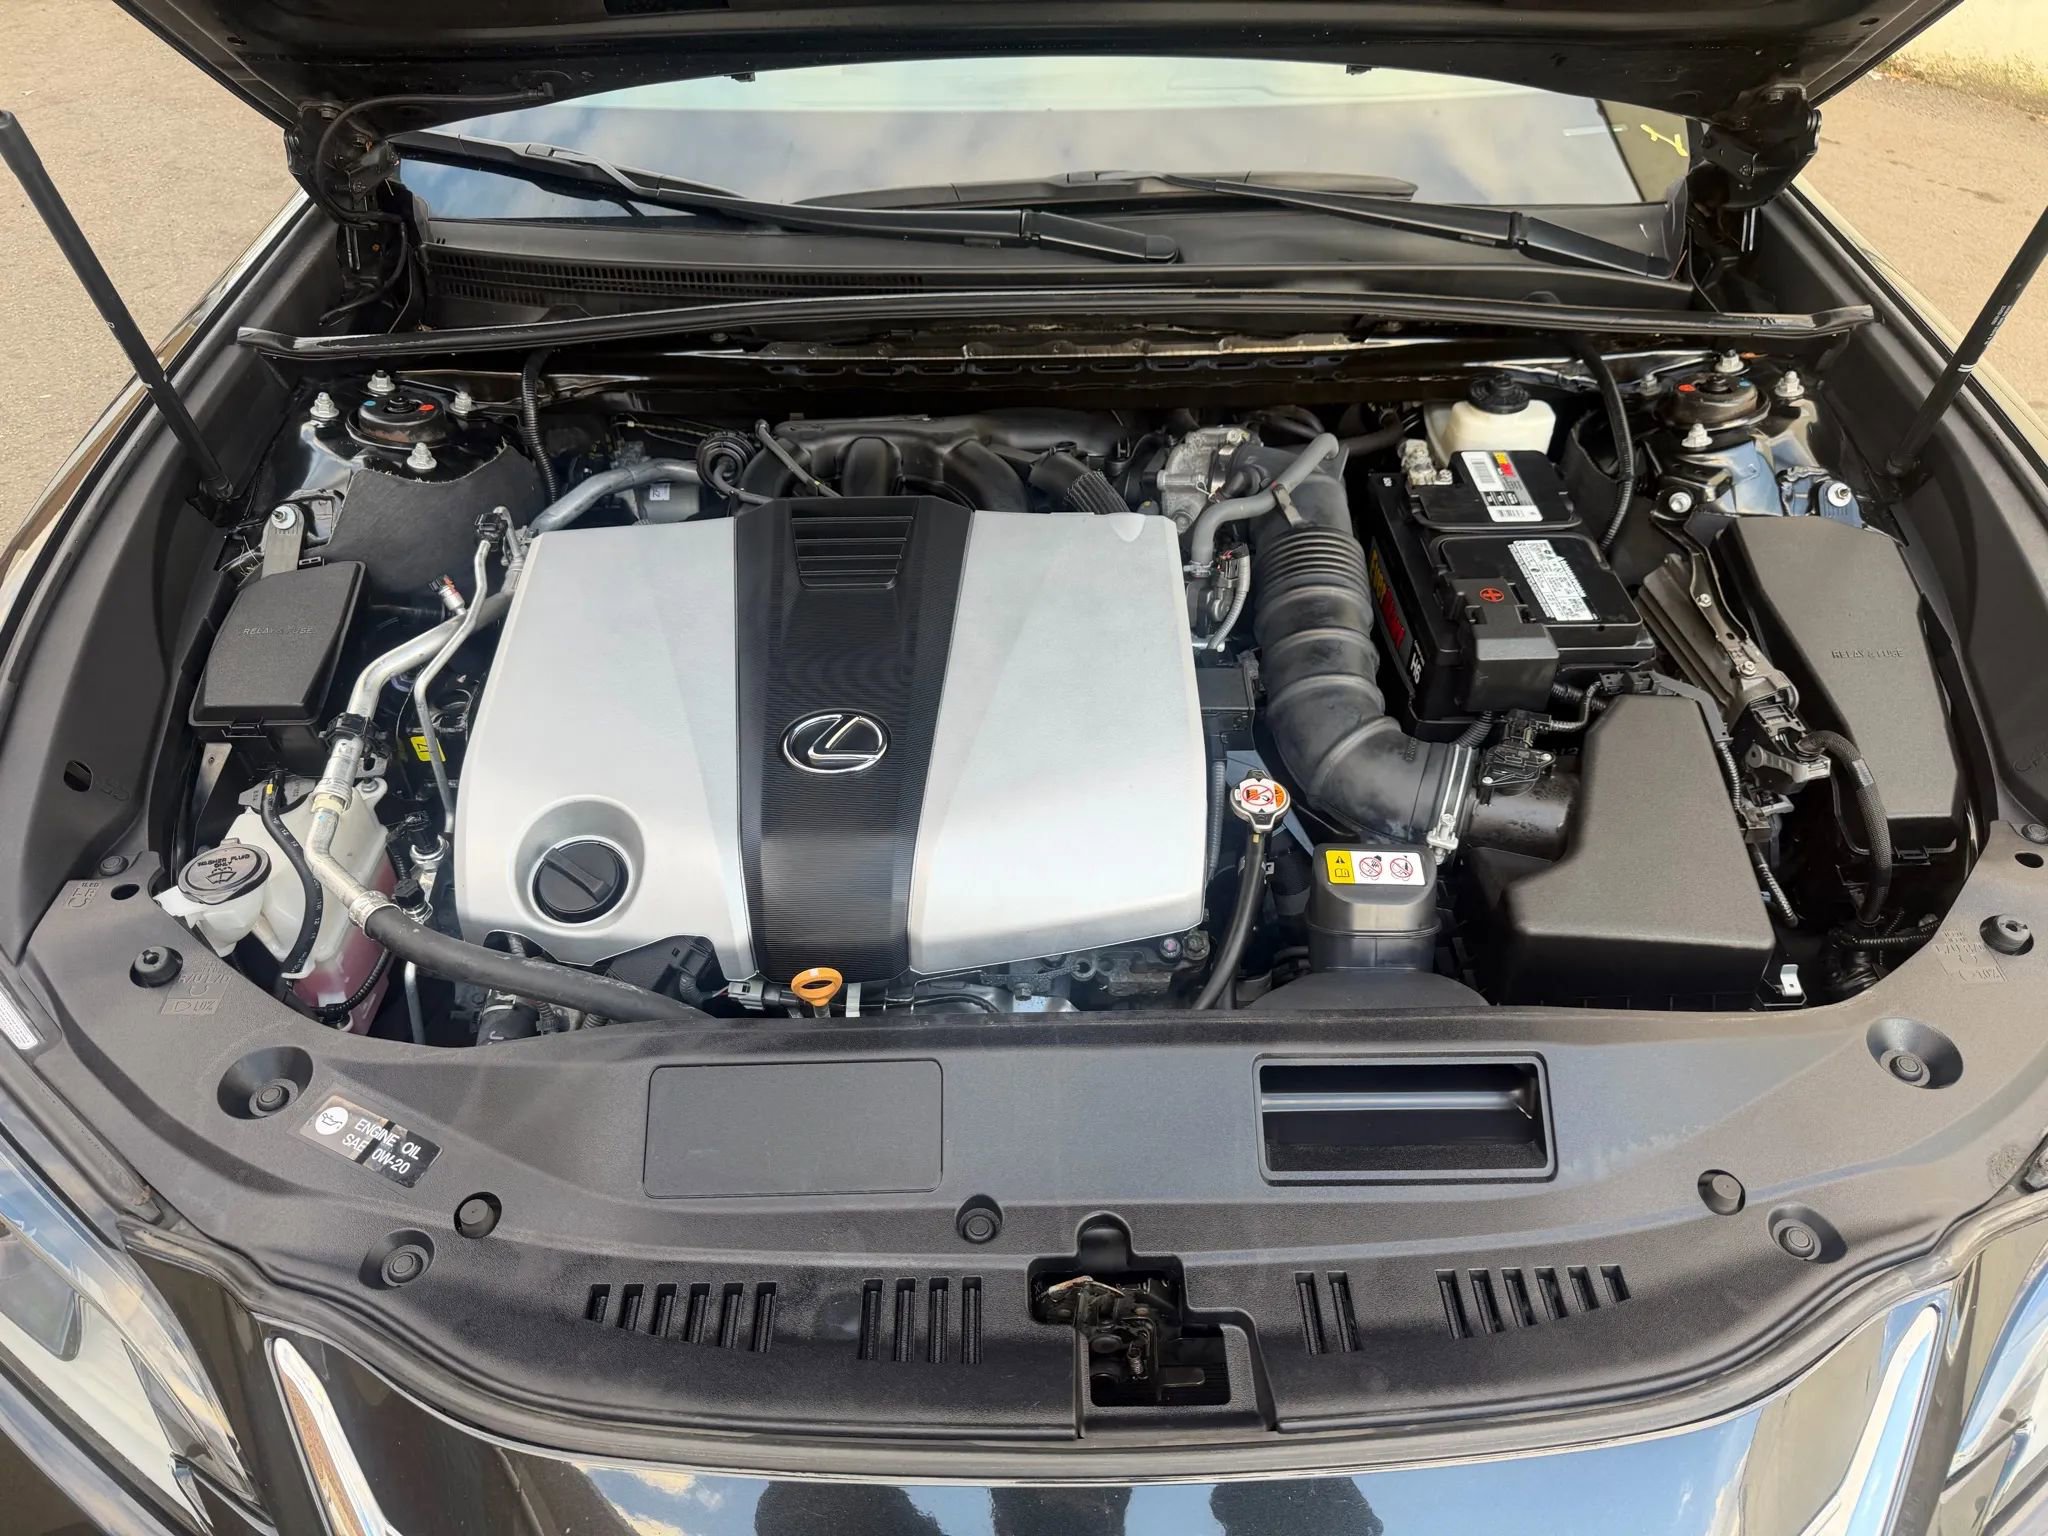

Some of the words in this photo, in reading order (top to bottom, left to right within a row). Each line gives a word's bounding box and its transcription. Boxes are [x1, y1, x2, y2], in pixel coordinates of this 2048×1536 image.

[1831, 649, 1865, 659] RELAY
[342, 1133, 370, 1153] SAE
[371, 1148, 411, 1174] 0W-20
[354, 1118, 400, 1147] ENGINE
[401, 1141, 421, 1161] OIL
